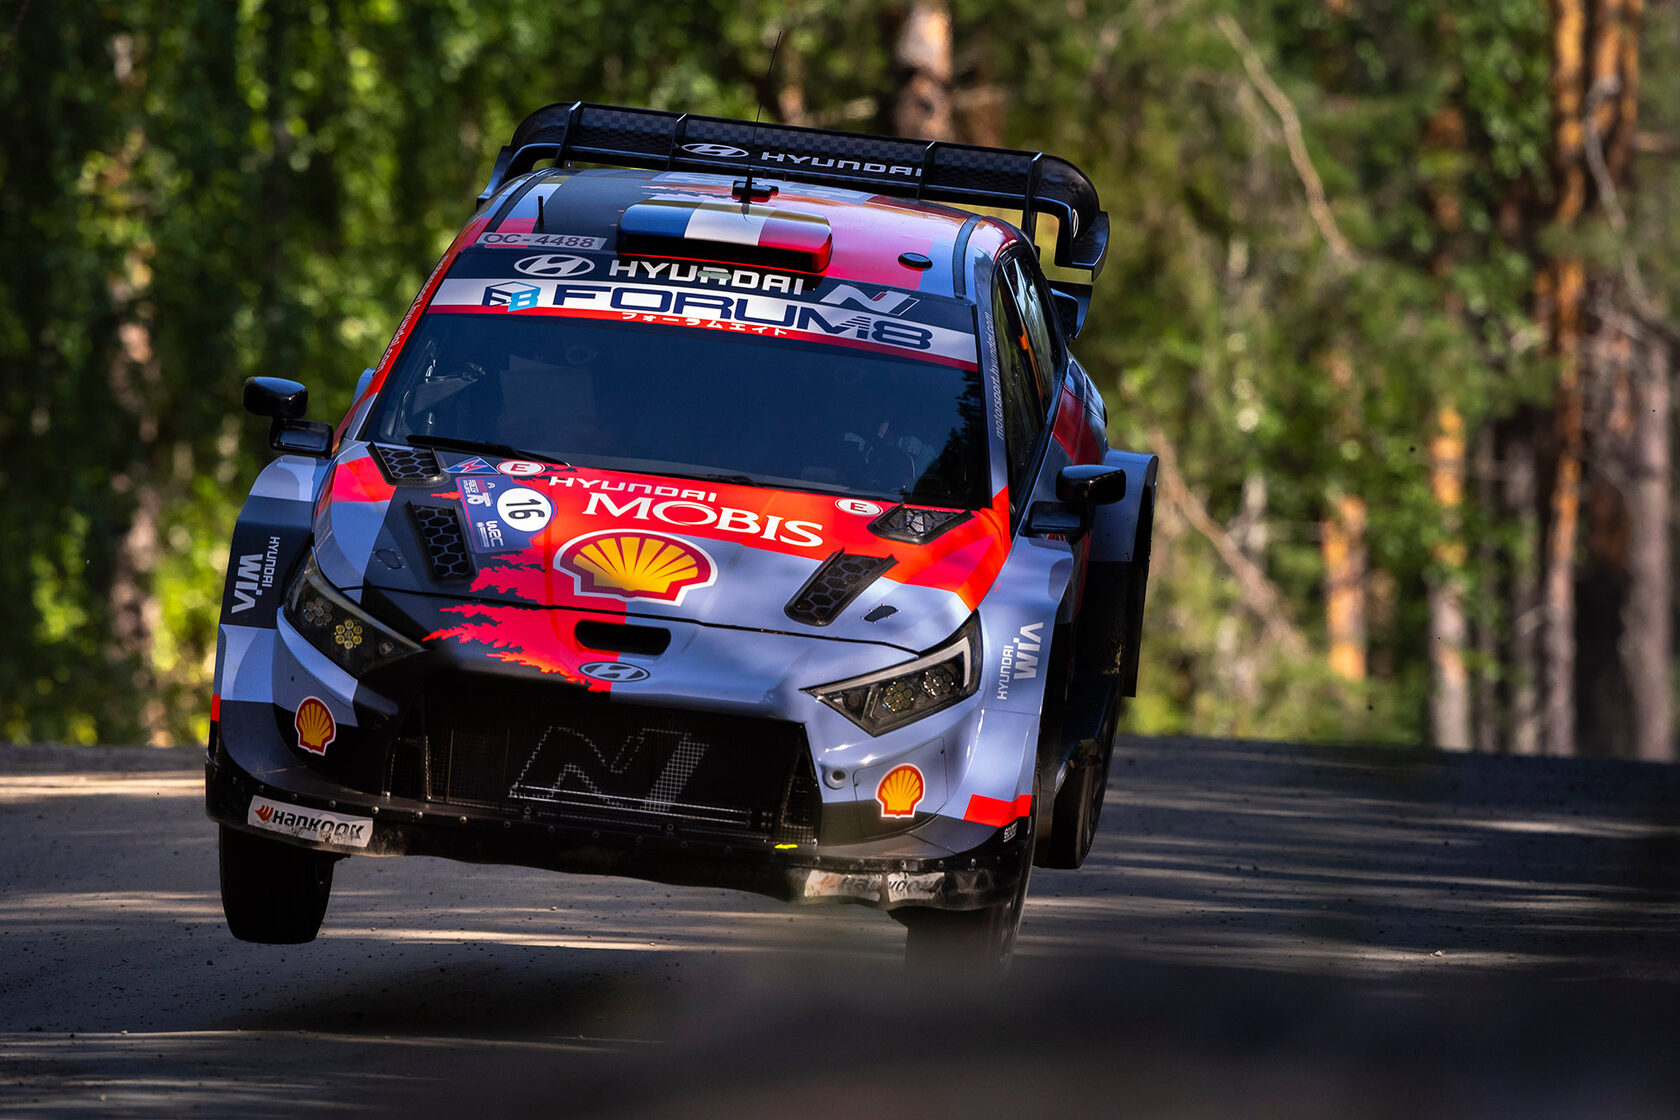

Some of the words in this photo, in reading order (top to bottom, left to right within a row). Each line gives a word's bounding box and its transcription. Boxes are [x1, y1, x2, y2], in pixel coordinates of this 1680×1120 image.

[760, 151, 922, 177] HYUNDAI
[609, 259, 804, 296] HYUNDAI
[553, 284, 933, 350] FORUM8
[622, 311, 788, 336] フォーラムエイト
[549, 476, 717, 502] HYUNDAI
[505, 498, 546, 520] 16
[582, 491, 824, 547] MOBIS
[261, 536, 281, 588] HYUNDAI
[997, 644, 1015, 700] HYUNDAI
